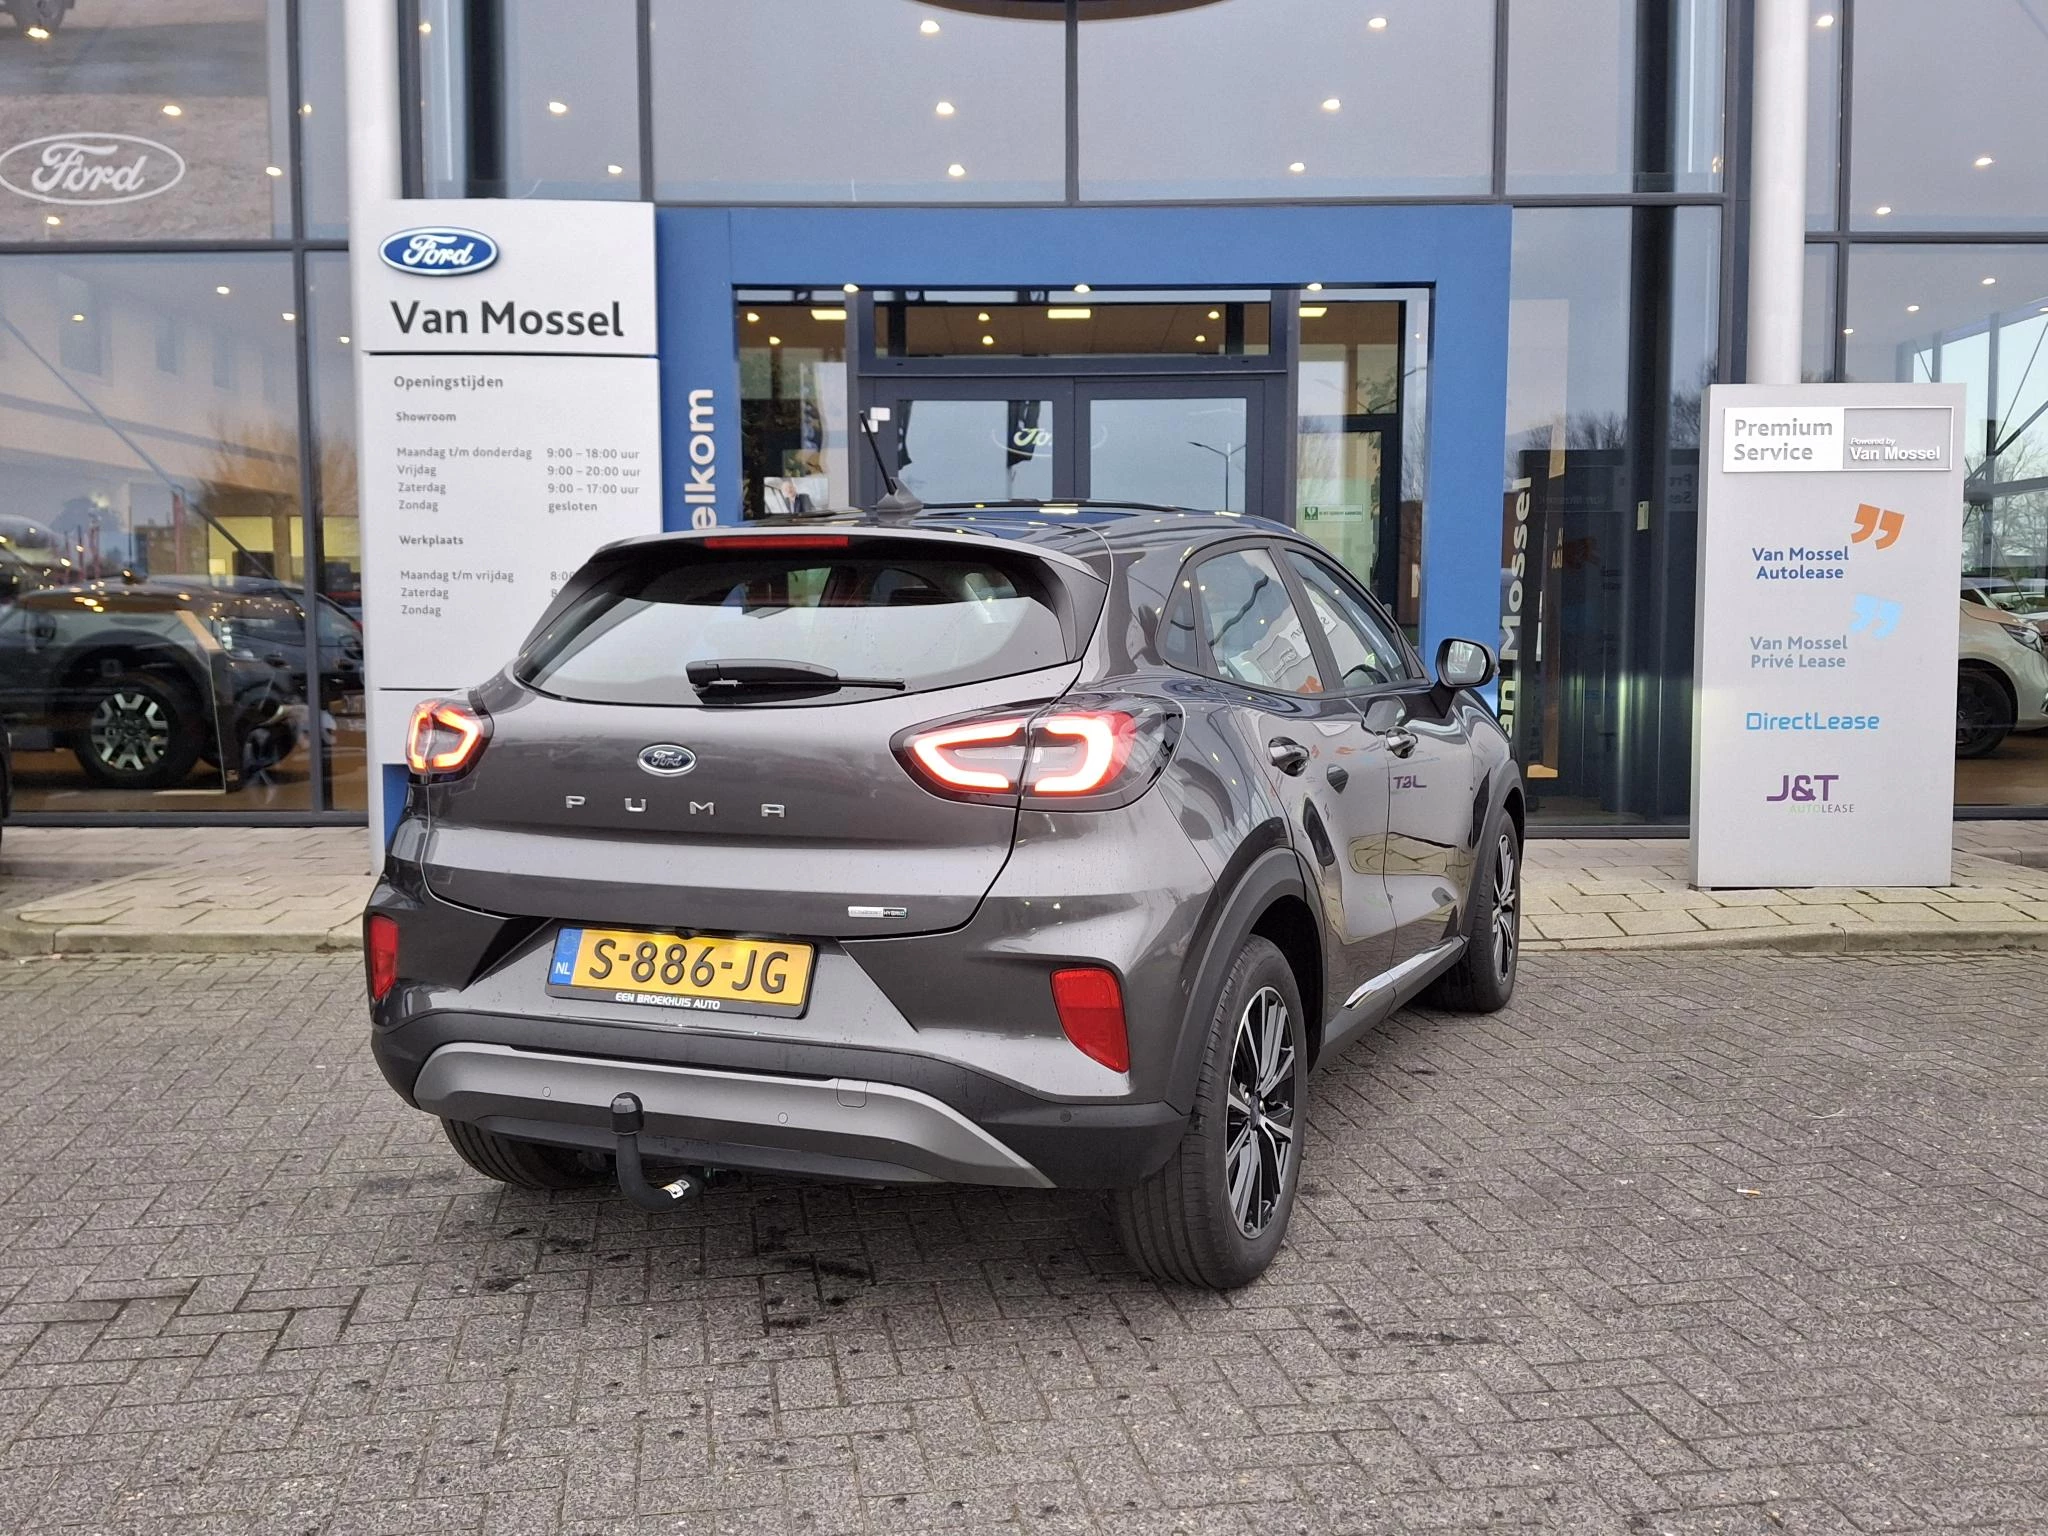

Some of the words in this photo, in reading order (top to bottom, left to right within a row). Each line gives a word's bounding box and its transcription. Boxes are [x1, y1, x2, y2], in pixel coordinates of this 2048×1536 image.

[30, 142, 147, 193] Ford
[402, 234, 474, 267] Ford
[391, 301, 469, 334] Van
[481, 301, 624, 336] Mossel
[394, 375, 503, 391] Openingstijden
[396, 411, 456, 422] Showroom
[1734, 418, 1832, 436] Premium
[1850, 437, 1885, 445] Powered
[1886, 437, 1896, 446] by
[397, 447, 446, 459] Maandag
[449, 446, 469, 458] t/m
[473, 447, 532, 460] donderdag
[547, 448, 573, 459] 9:00
[586, 448, 617, 459] 18:00
[621, 450, 640, 459] uur
[1734, 443, 1813, 460] Service
[1850, 446, 1880, 460] Van
[1884, 446, 1941, 460] Mossel
[684, 389, 717, 531] elkom
[397, 464, 436, 477] Vrijdag
[547, 465, 574, 476] 9:00
[586, 466, 618, 477] 20:00
[622, 468, 640, 477] uur
[398, 482, 446, 495] Zaterdag
[548, 483, 574, 494] 9:00
[587, 484, 617, 494] 17:00
[621, 486, 640, 495] uur
[398, 500, 438, 513] Zondag
[548, 501, 598, 514] gesloten
[399, 535, 464, 547] Werkplaats
[1752, 548, 1783, 561] Van
[1790, 546, 1849, 561] Mossel
[1500, 477, 1532, 660] Mossel
[1757, 565, 1844, 579] Autolease
[400, 570, 449, 582] Maandag
[452, 570, 473, 580] t/m
[475, 570, 514, 583] vrijdag
[401, 587, 449, 599] Zaterdag
[401, 605, 441, 617] Zondag
[1750, 636, 1782, 650] Van
[1788, 635, 1847, 650] Mossel
[1751, 653, 1794, 668] Privé
[1799, 655, 1846, 668] Lease
[1746, 712, 1880, 730] DirectLease
[651, 750, 682, 766] Ford
[1766, 775, 1839, 801] J&T
[565, 795, 785, 818] PUMA
[1790, 804, 1855, 814] AUTOLEASE
[555, 961, 571, 976] NL
[589, 938, 789, 994] S-886-JG
[615, 992, 635, 1003] EEN
[637, 994, 691, 1008] BROEKHUIS
[693, 1000, 721, 1010] AUTO
